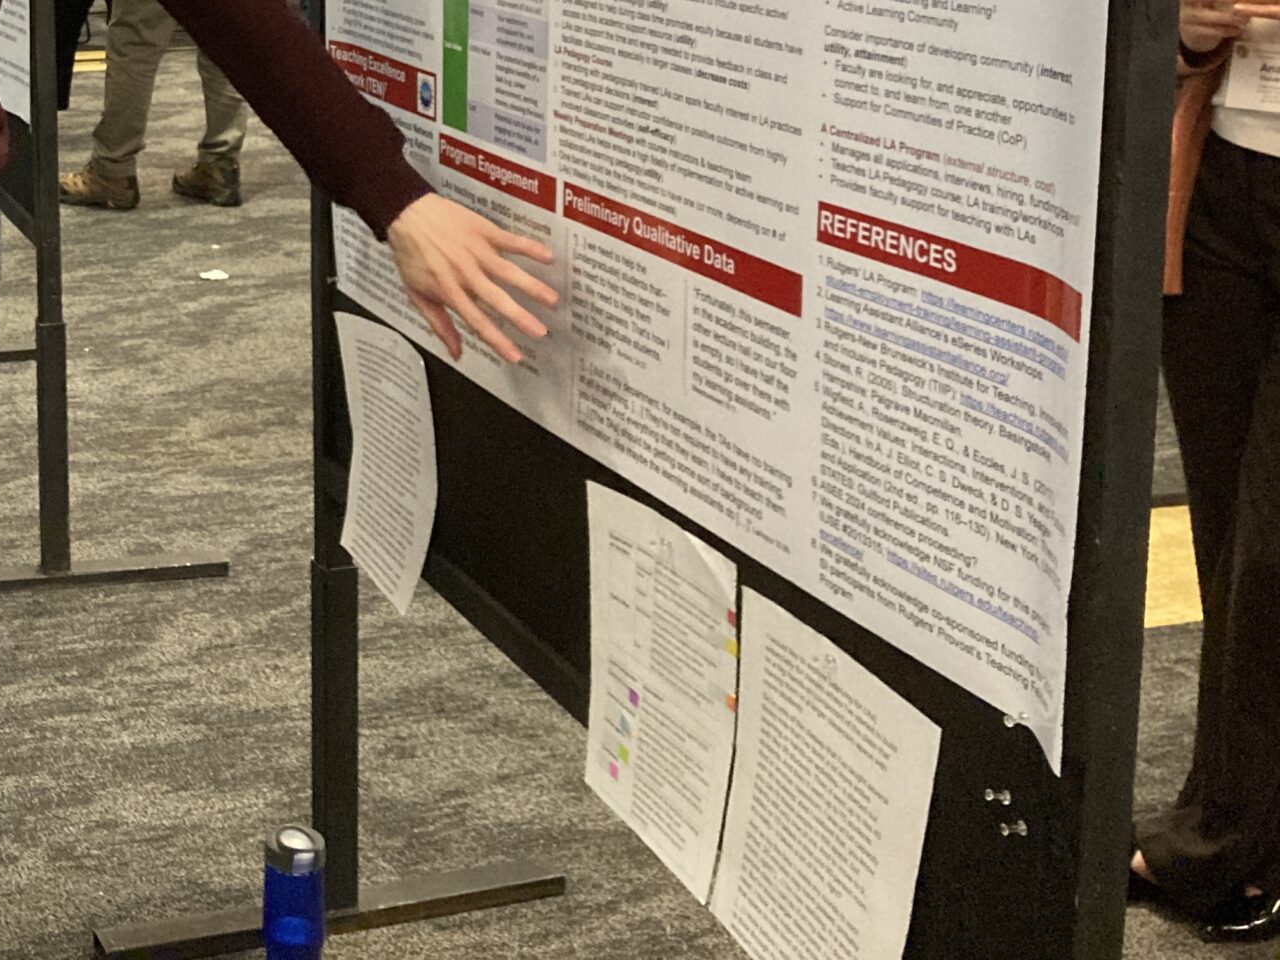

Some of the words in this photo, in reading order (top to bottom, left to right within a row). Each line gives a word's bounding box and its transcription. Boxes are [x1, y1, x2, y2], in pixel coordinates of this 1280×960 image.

[330, 45, 368, 71] Teaching
[368, 56, 406, 83] Excellence
[944, 118, 955, 130] of
[440, 138, 475, 170] Program
[478, 152, 539, 195] Engagement
[564, 188, 630, 234] Preliminary
[632, 215, 700, 260] Qualitative
[703, 244, 736, 275] Data
[820, 210, 957, 272] REFERENCES
[994, 220, 1015, 237] with
[1017, 230, 1036, 246] LAs
